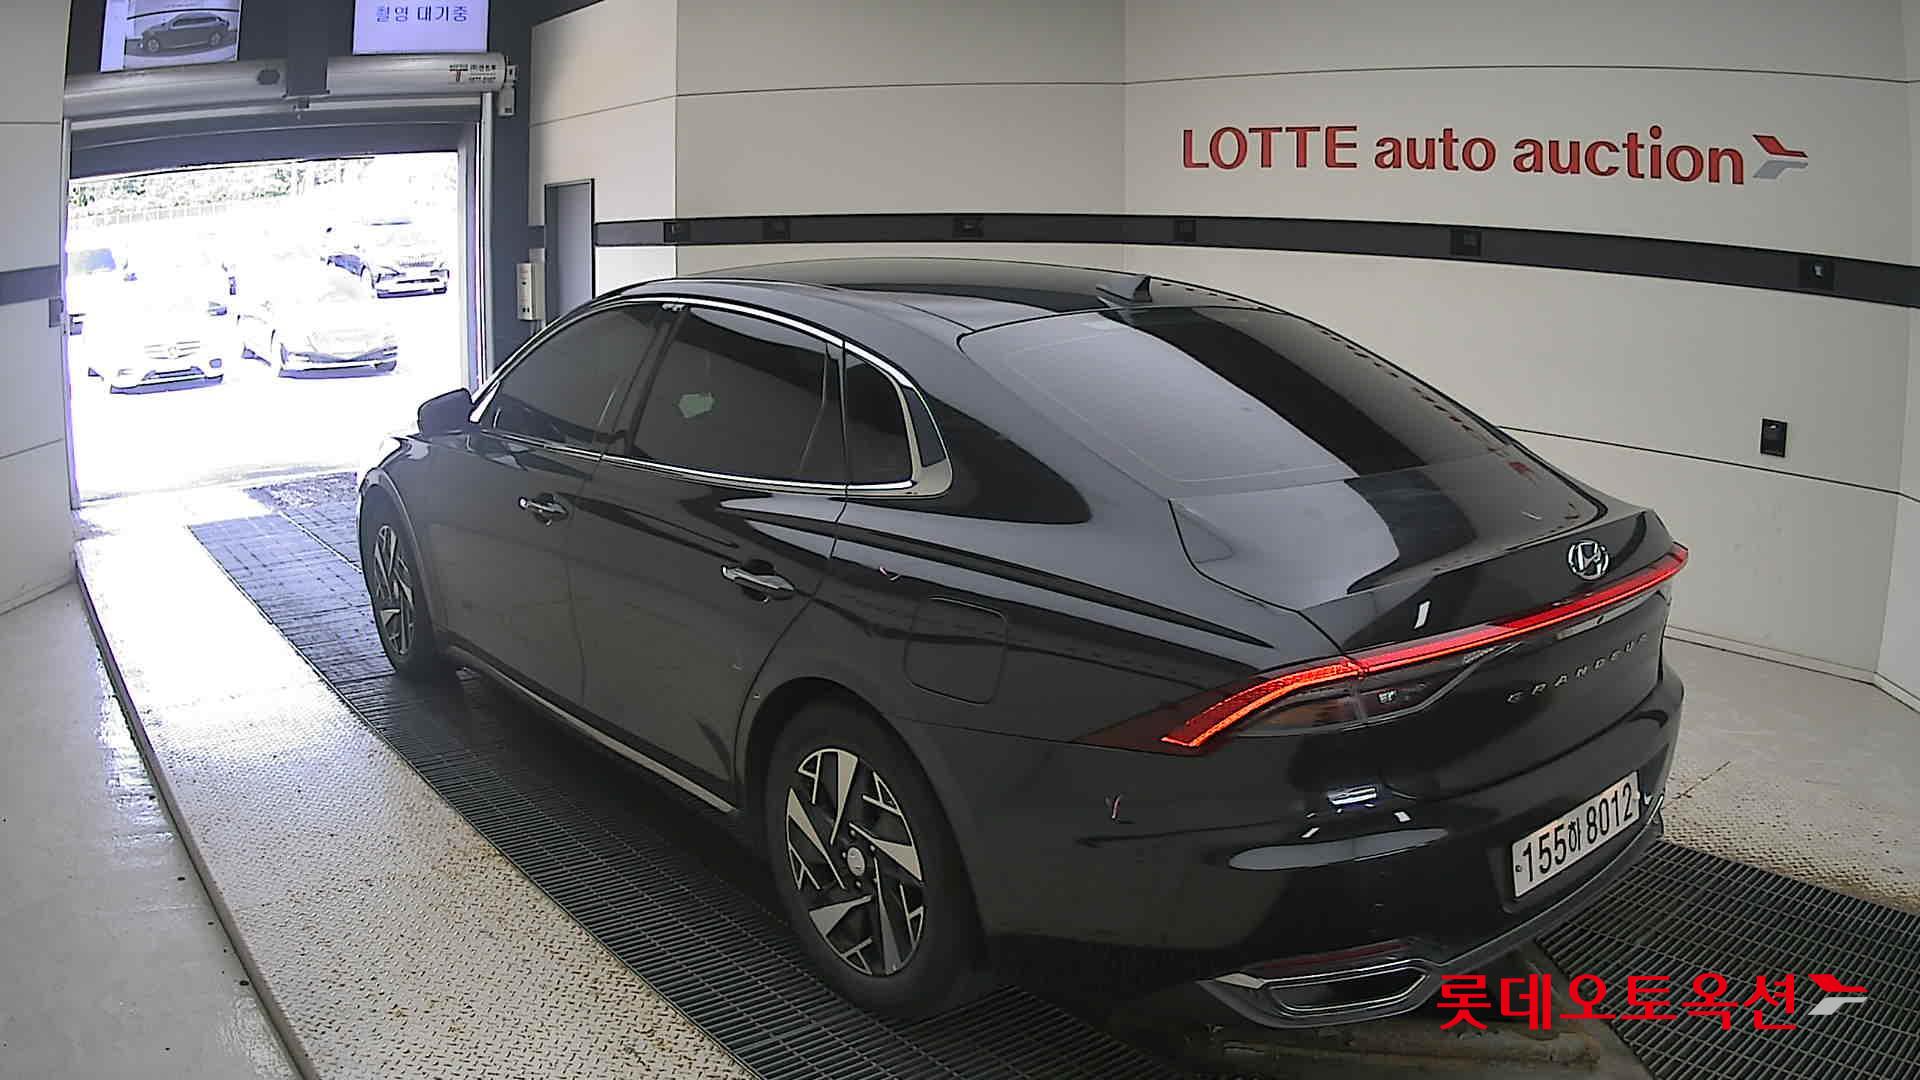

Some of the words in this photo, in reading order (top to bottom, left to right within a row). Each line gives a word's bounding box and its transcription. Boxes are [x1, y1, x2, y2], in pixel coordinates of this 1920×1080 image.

[417, 5, 468, 22] 대기중
[1183, 126, 1358, 170] LOTTE
[1374, 127, 1497, 172] auto
[1512, 125, 1745, 185] auction
[1586, 782, 1633, 844] 8012
